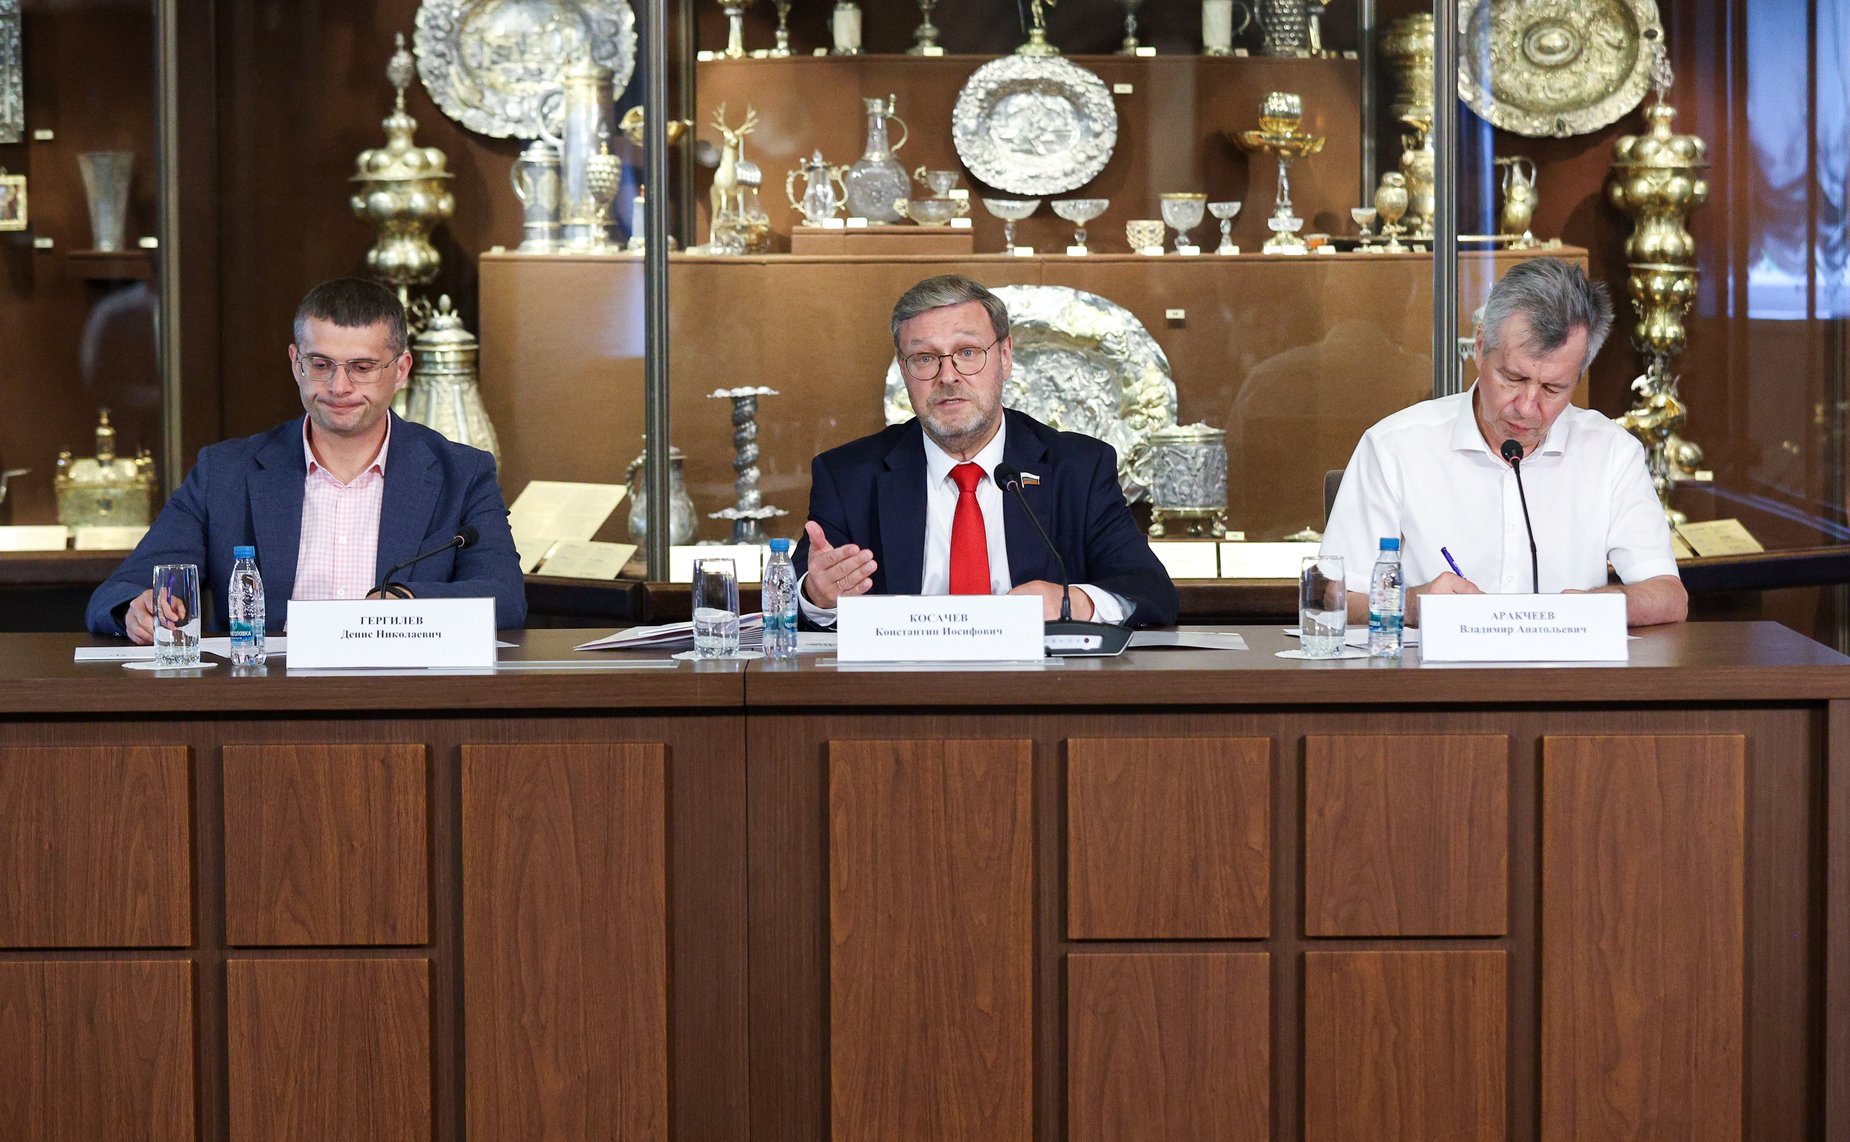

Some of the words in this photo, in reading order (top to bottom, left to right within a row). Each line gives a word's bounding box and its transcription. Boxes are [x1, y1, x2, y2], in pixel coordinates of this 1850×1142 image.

[909, 613, 968, 622] КОСАЧЕВ
[1491, 611, 1555, 620] АРАКЧЕЕВ
[360, 616, 424, 625] ГЕРГИЛЕВ
[340, 629, 373, 639] Денис
[376, 629, 441, 638] Николаевич
[875, 627, 939, 636] Константин
[943, 626, 1002, 637] Иосифович
[1460, 624, 1513, 635] Владимир
[1518, 625, 1587, 634] Анатольевич
